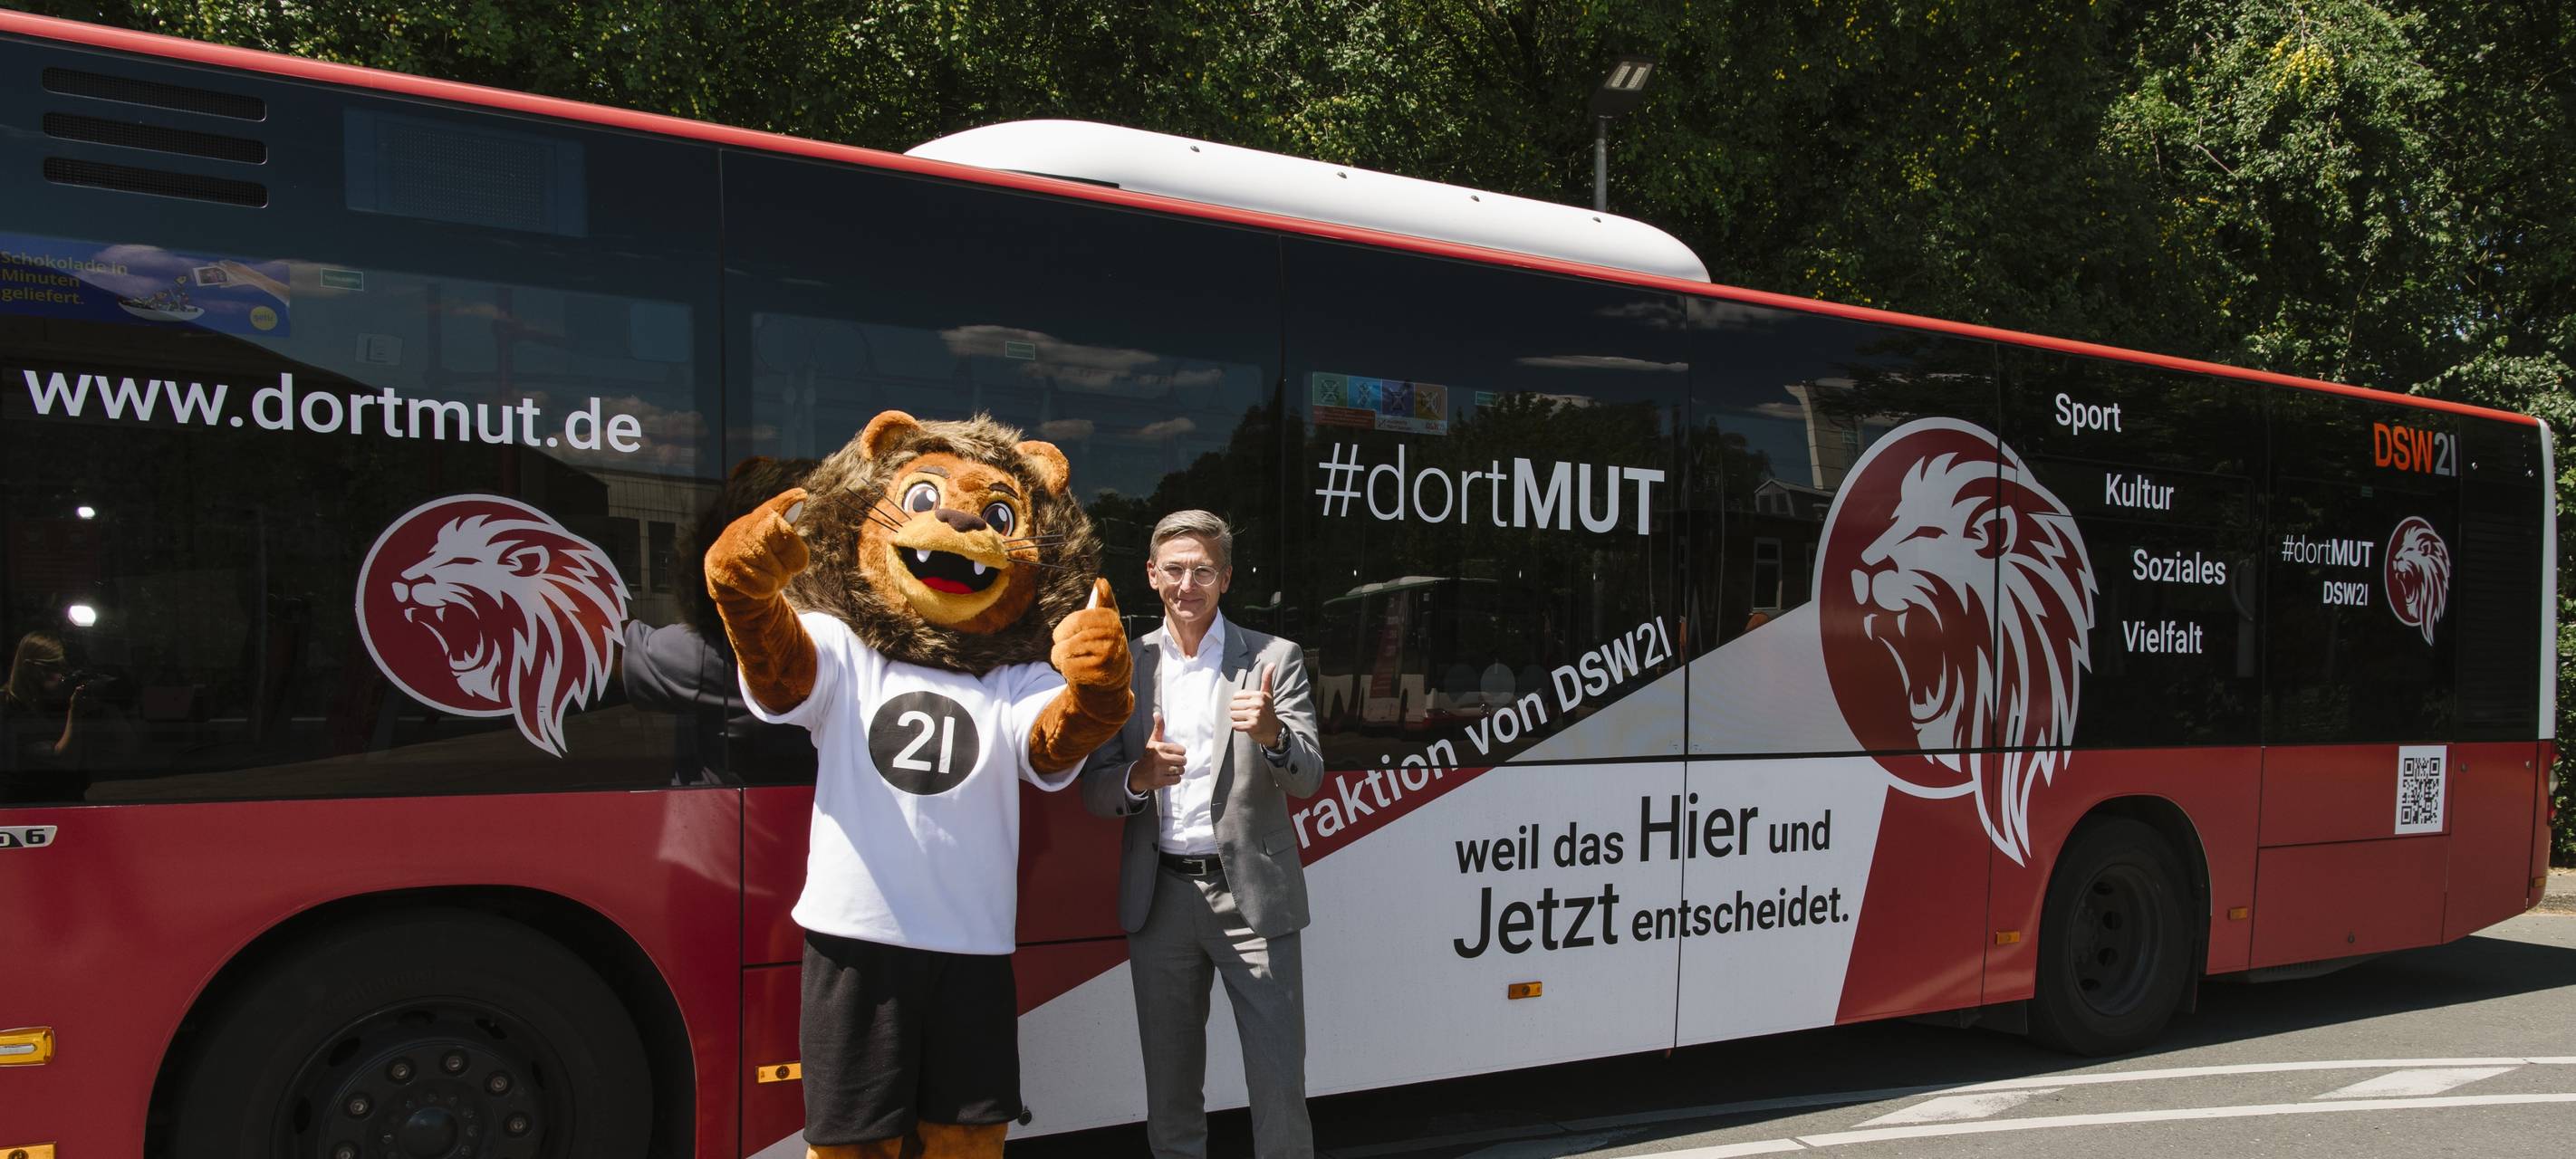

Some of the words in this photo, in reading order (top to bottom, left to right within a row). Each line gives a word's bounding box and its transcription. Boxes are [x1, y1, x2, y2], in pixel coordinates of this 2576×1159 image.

[0, 250, 105, 273] Schokolade
[111, 261, 129, 275] in
[1, 269, 81, 287] Minuten
[1, 287, 86, 304] geliefert.
[24, 369, 643, 454] www.dortmut.de
[2055, 393, 2121, 436] Sport
[1315, 442, 1665, 535] #dortMUT
[2105, 473, 2174, 510] Kultur
[2133, 549, 2226, 585] Soziales
[2282, 534, 2374, 568] #dortMUT
[2123, 620, 2203, 654] Vielfalt
[1293, 738, 1458, 849] raktion
[1464, 691, 1547, 755] von
[1455, 823, 1540, 873] weil
[1553, 822, 1624, 867] das
[1639, 792, 1759, 862] Hier
[1769, 809, 1831, 853] und
[1454, 884, 1620, 958] Jetzt
[1632, 886, 1850, 943] entscheidet.
